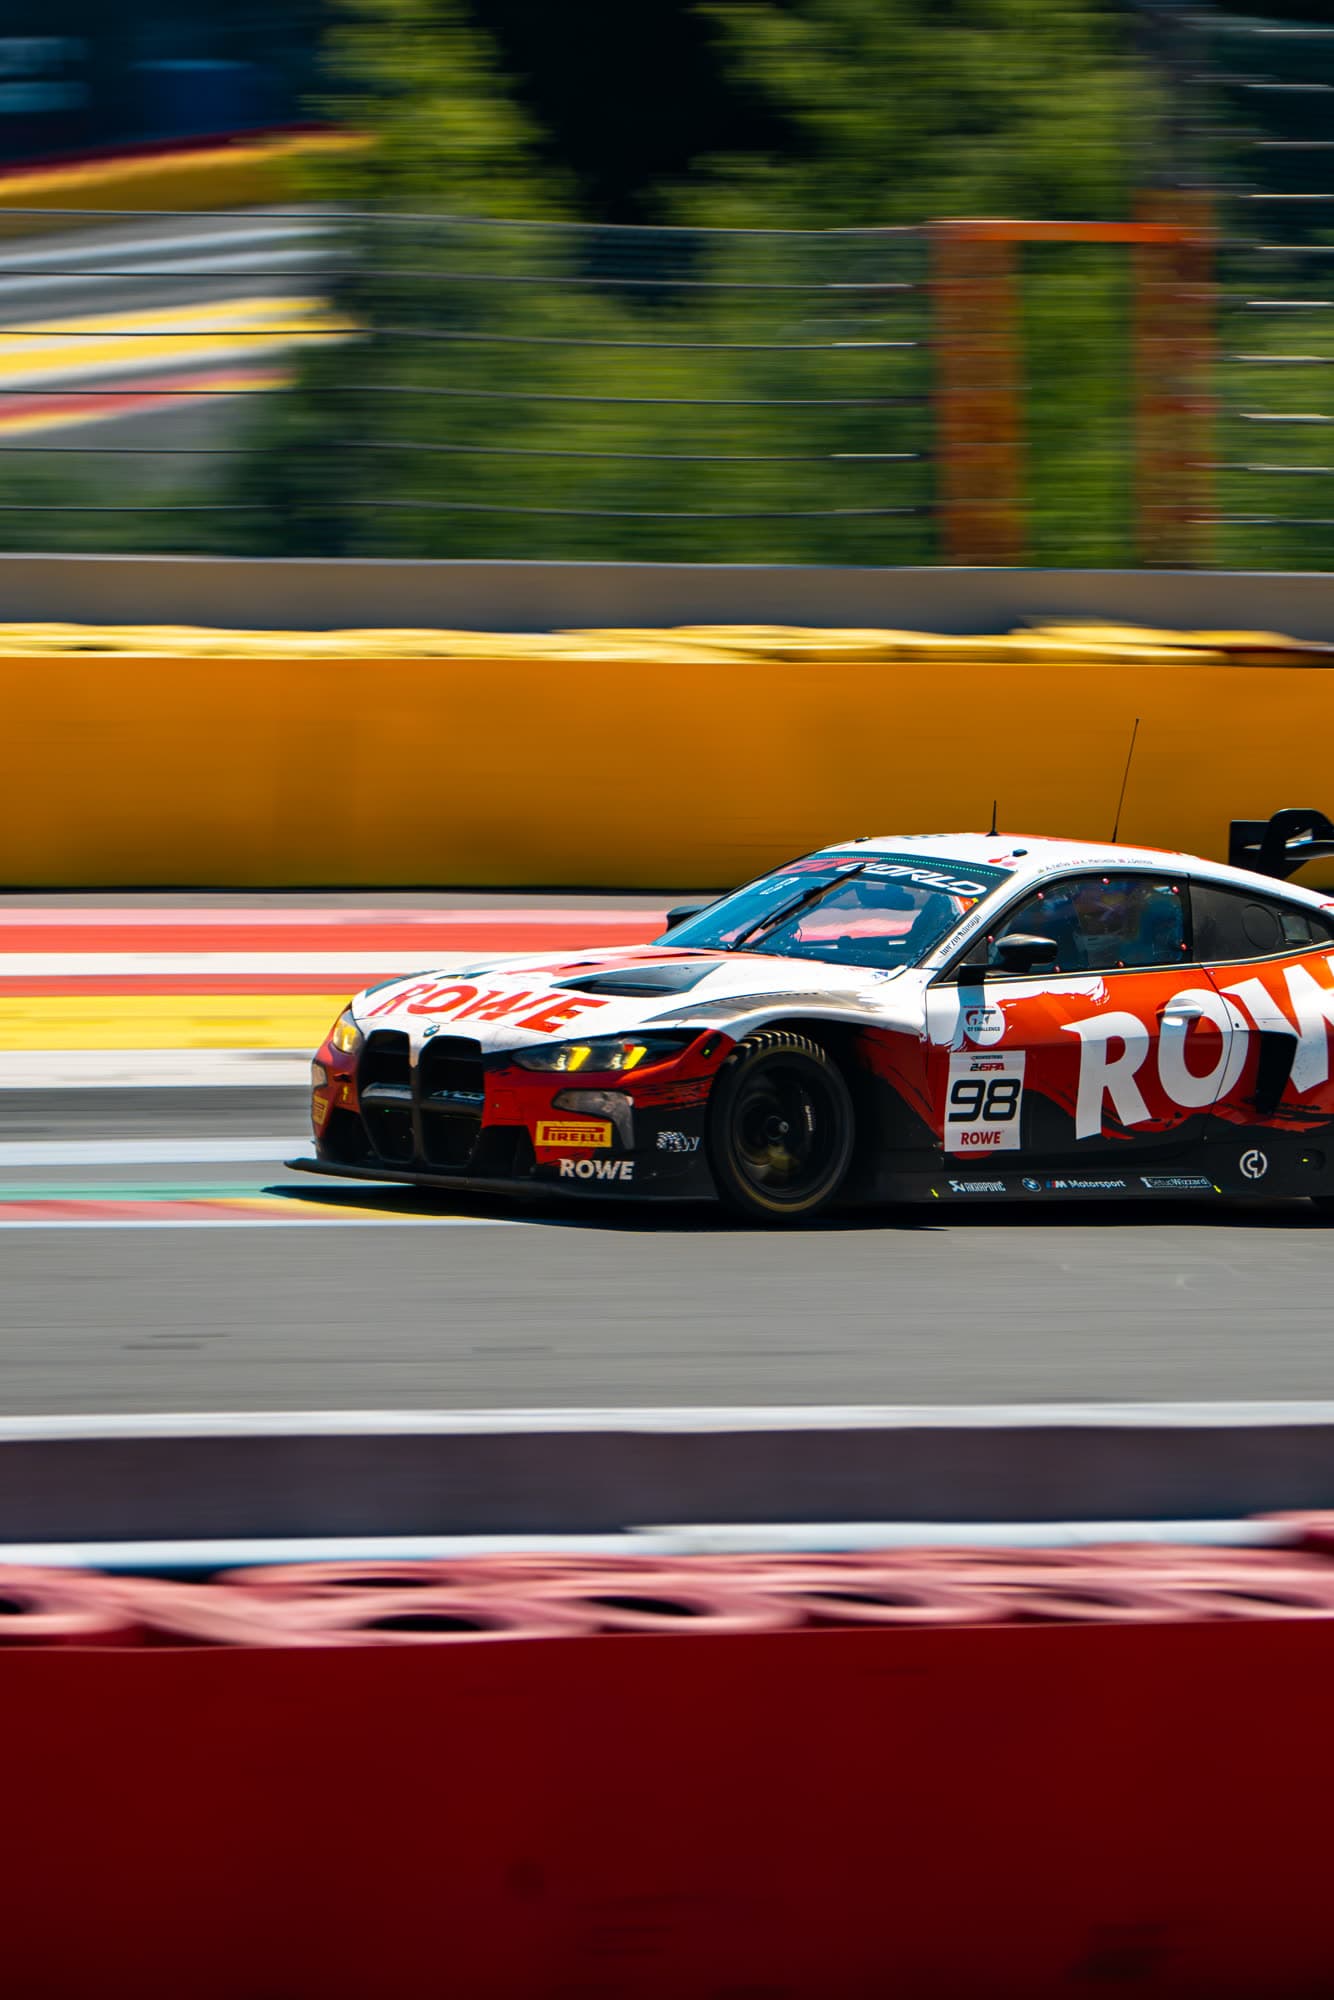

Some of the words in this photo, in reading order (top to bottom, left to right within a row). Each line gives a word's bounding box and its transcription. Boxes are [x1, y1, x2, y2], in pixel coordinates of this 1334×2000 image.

[367, 983, 610, 1033] ROWE
[948, 1078, 1021, 1122] 98
[542, 1125, 606, 1142] PIRELLI
[960, 1131, 1001, 1145] ROWE
[558, 1158, 635, 1181] ROWE
[1068, 1179, 1127, 1189] Motorsport
